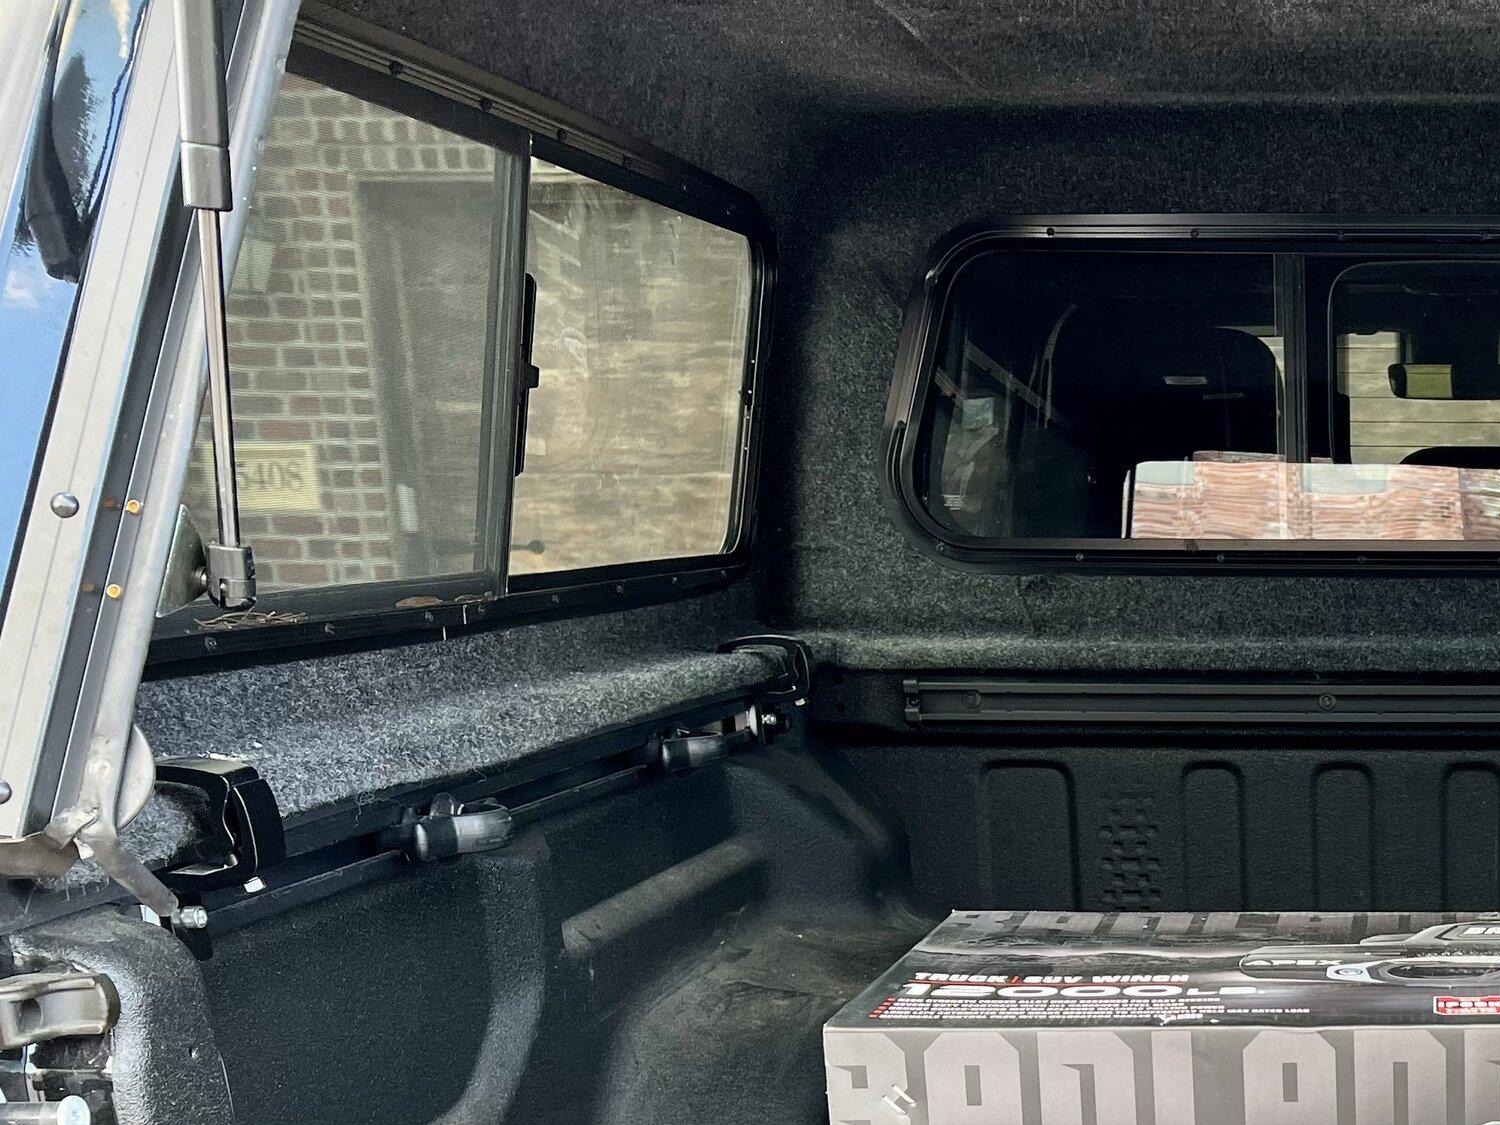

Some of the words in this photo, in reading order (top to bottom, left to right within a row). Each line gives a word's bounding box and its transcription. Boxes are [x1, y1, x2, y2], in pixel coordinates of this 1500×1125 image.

[914, 972, 1009, 983] TRUCK
[1023, 975, 1083, 984] SUV
[1091, 974, 1190, 983] WINCH
